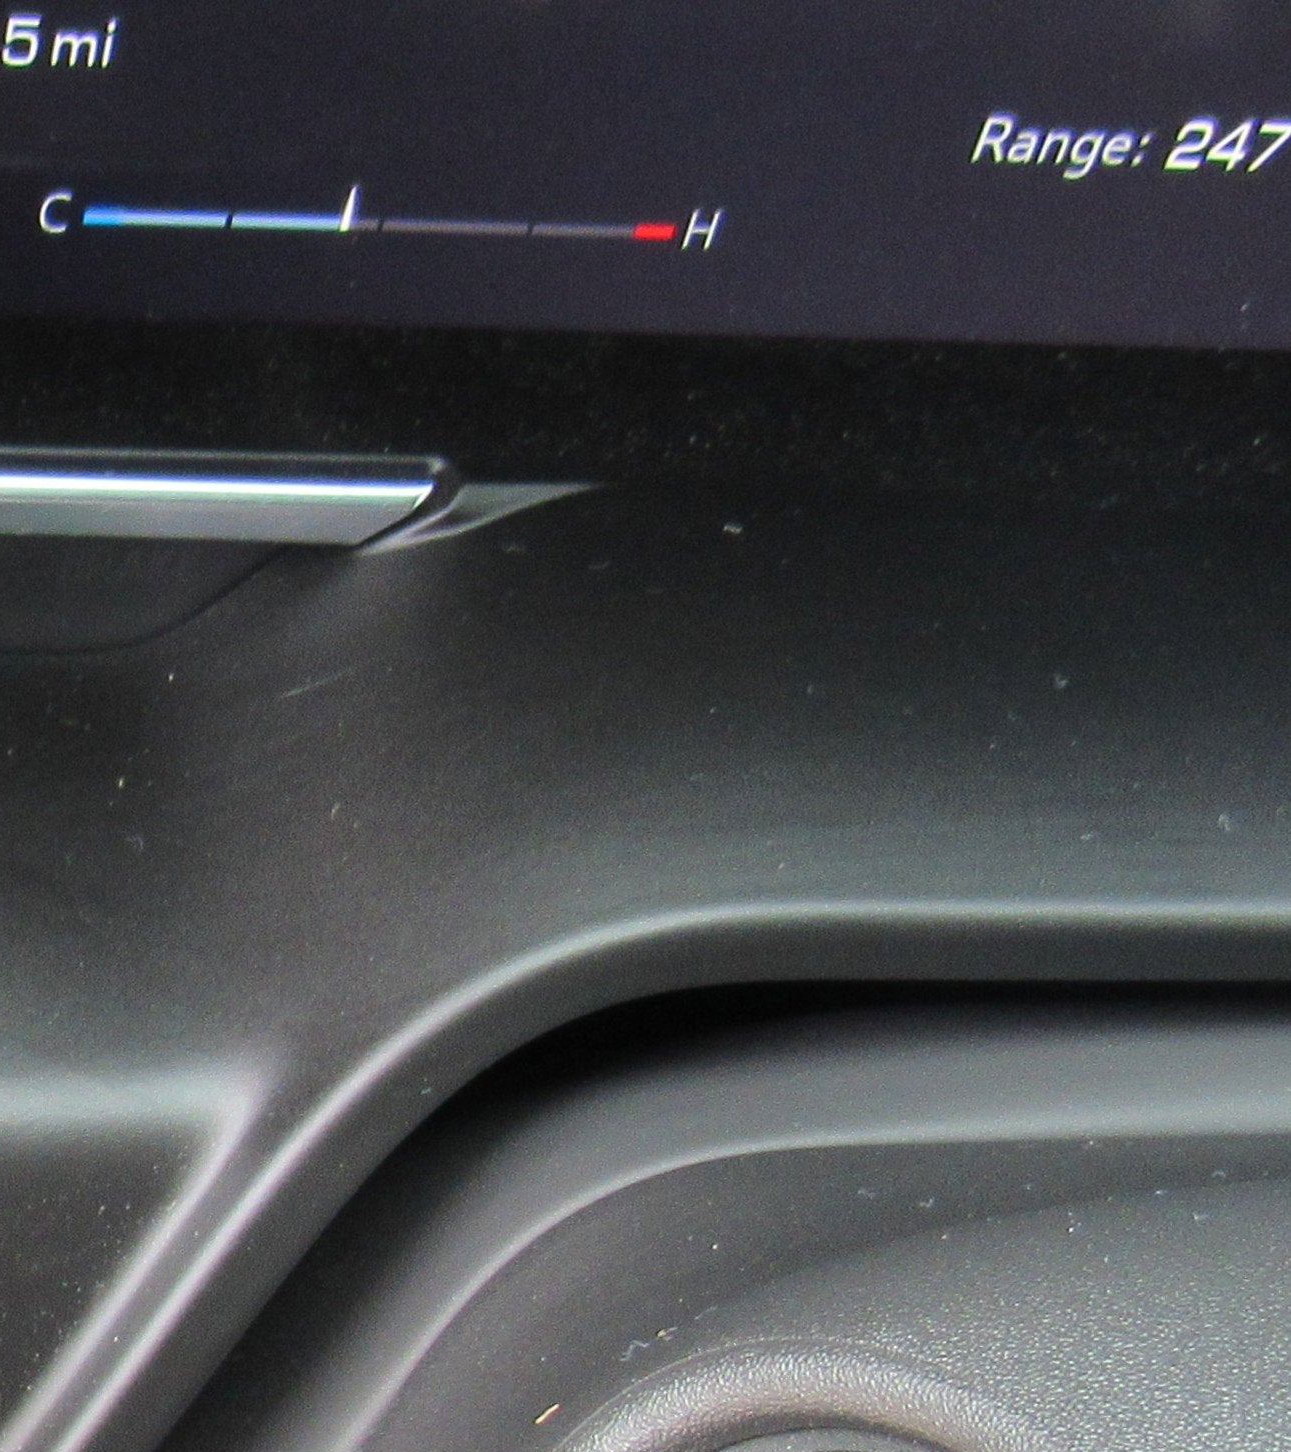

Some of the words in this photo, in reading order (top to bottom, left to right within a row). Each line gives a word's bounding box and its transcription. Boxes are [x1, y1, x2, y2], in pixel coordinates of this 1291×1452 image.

[2, 13, 41, 68] 5
[50, 18, 118, 69] mi
[970, 113, 1152, 180] Range:
[1163, 116, 1291, 173] 247
[38, 190, 73, 234] C
[681, 209, 723, 250] H
